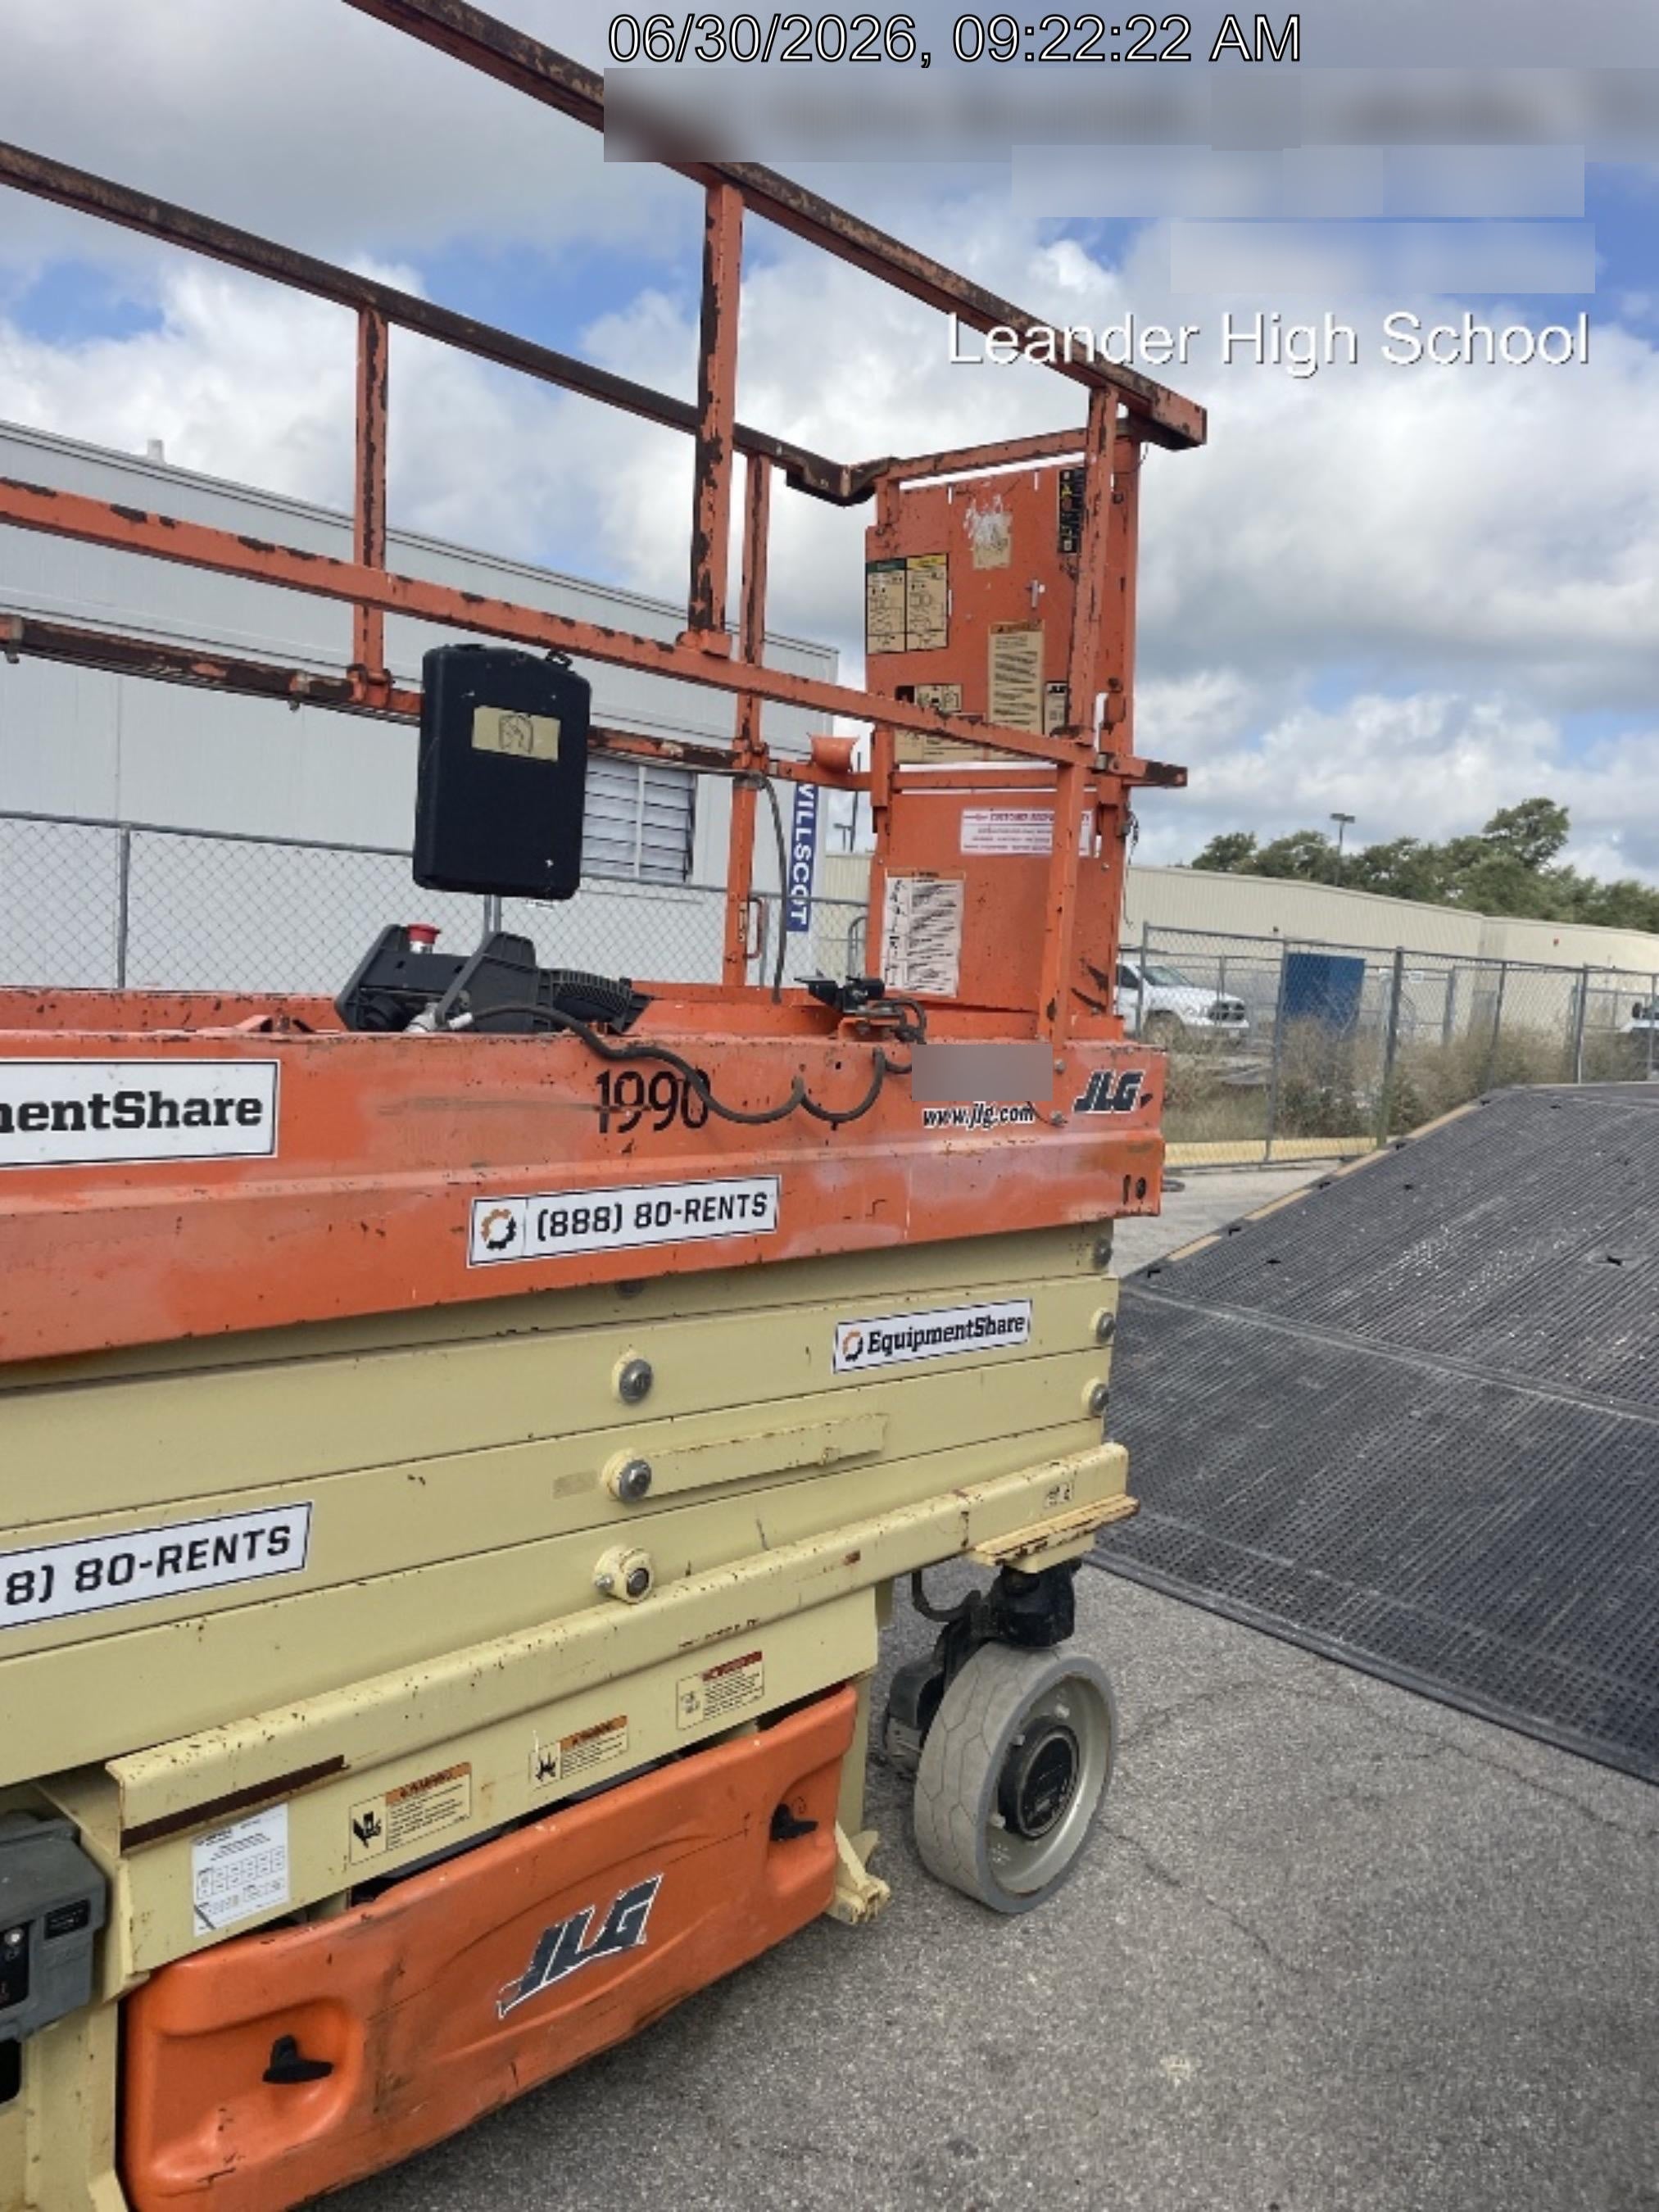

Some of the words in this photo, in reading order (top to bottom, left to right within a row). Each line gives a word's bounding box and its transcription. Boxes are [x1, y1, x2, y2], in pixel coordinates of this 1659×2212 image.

[1072, 1069, 1145, 1113] JLG
[537, 1202, 623, 1242] (888)
[634, 1191, 768, 1229] 80-RENTS
[867, 1315, 1025, 1357] EquipmentShare
[75, 1525, 291, 1593] 80-RENTS
[496, 1873, 663, 2019] JLG
